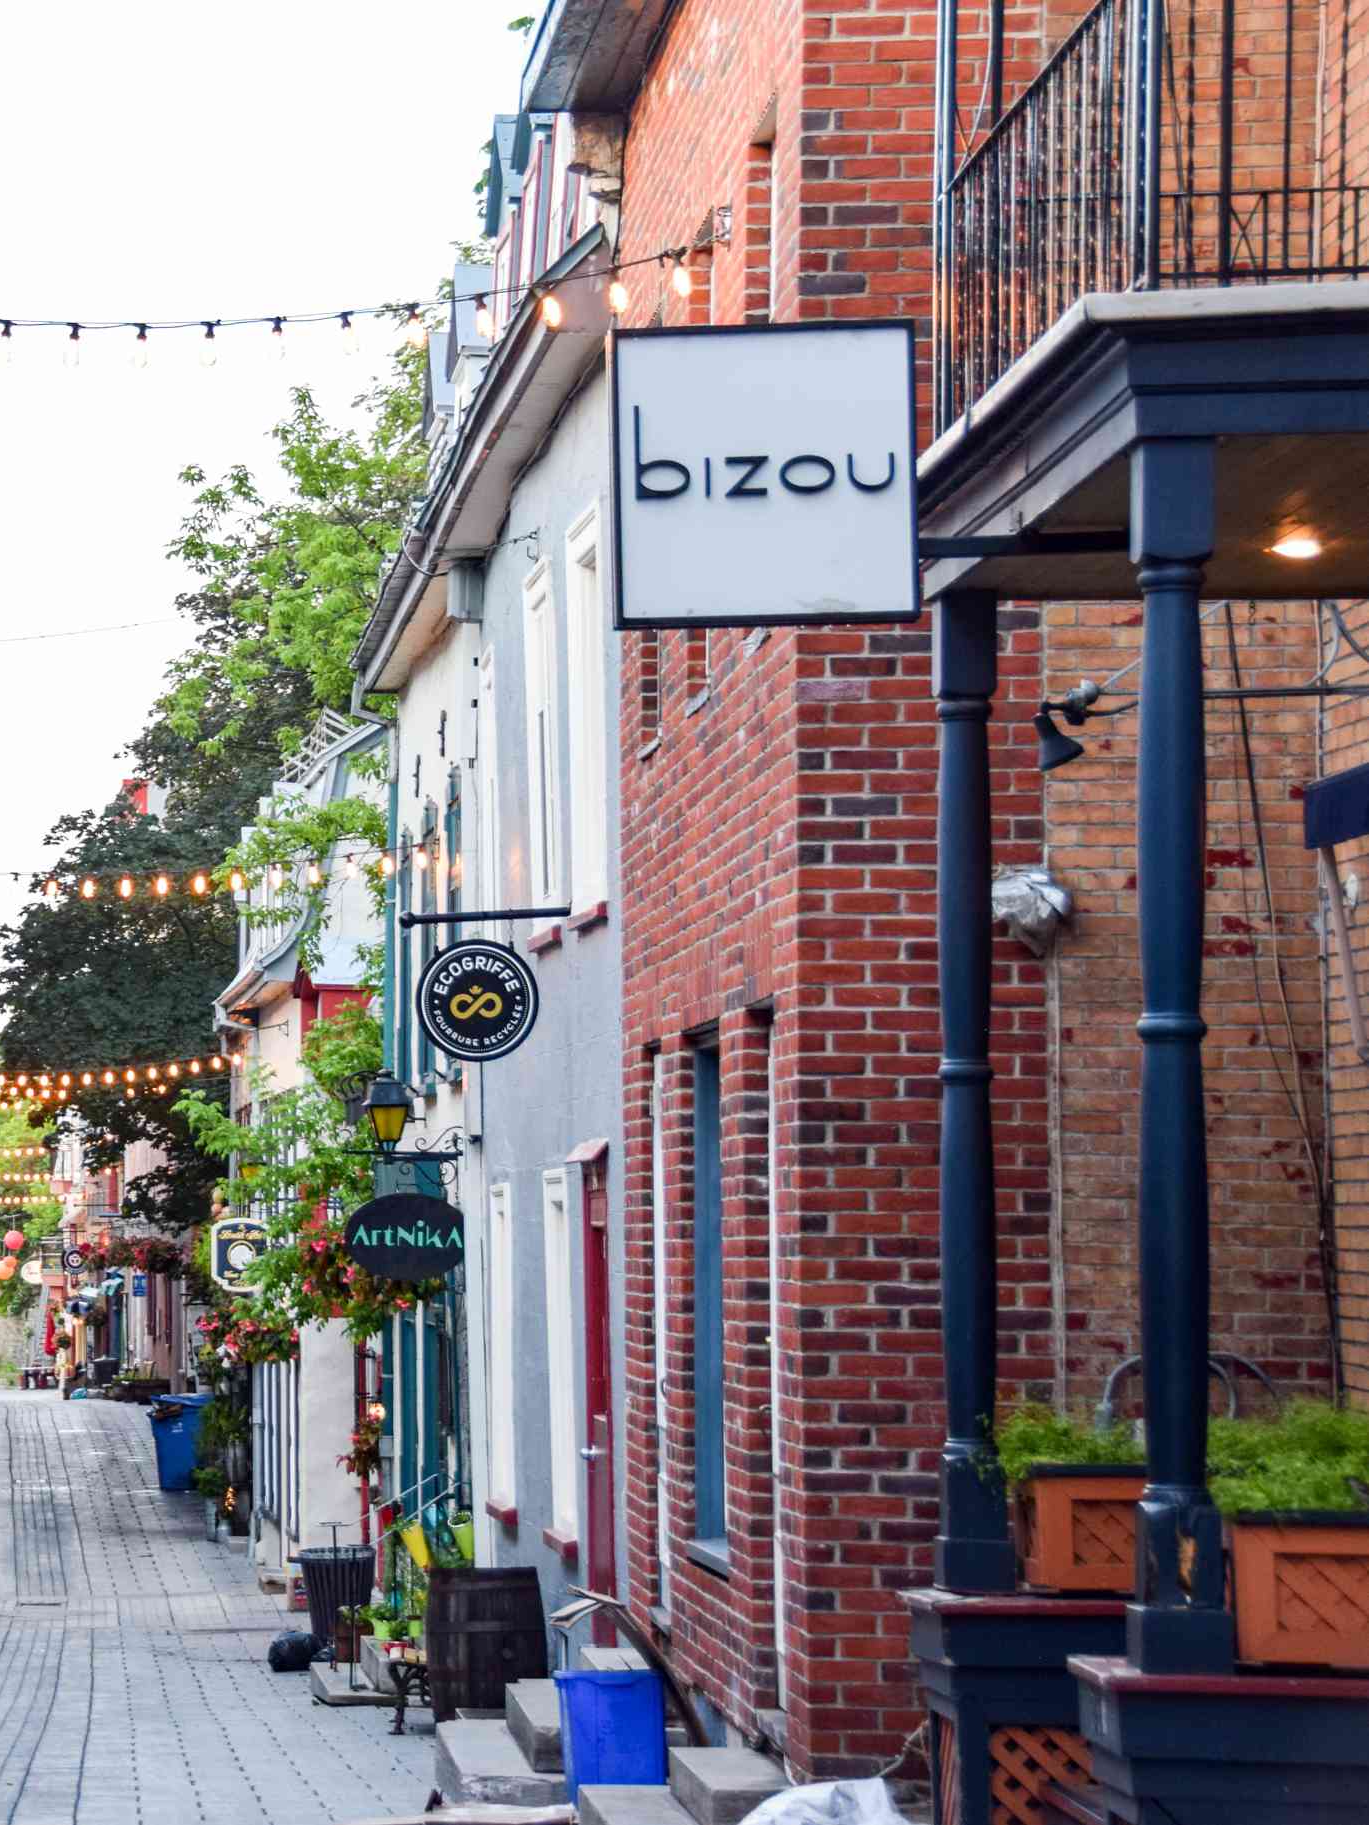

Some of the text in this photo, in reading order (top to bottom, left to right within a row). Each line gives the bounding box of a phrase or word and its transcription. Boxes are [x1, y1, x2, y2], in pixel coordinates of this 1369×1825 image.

[634, 405, 895, 501] bizou
[433, 956, 521, 995] ECOGRIFFE
[434, 1009, 480, 1047] FOURRURE
